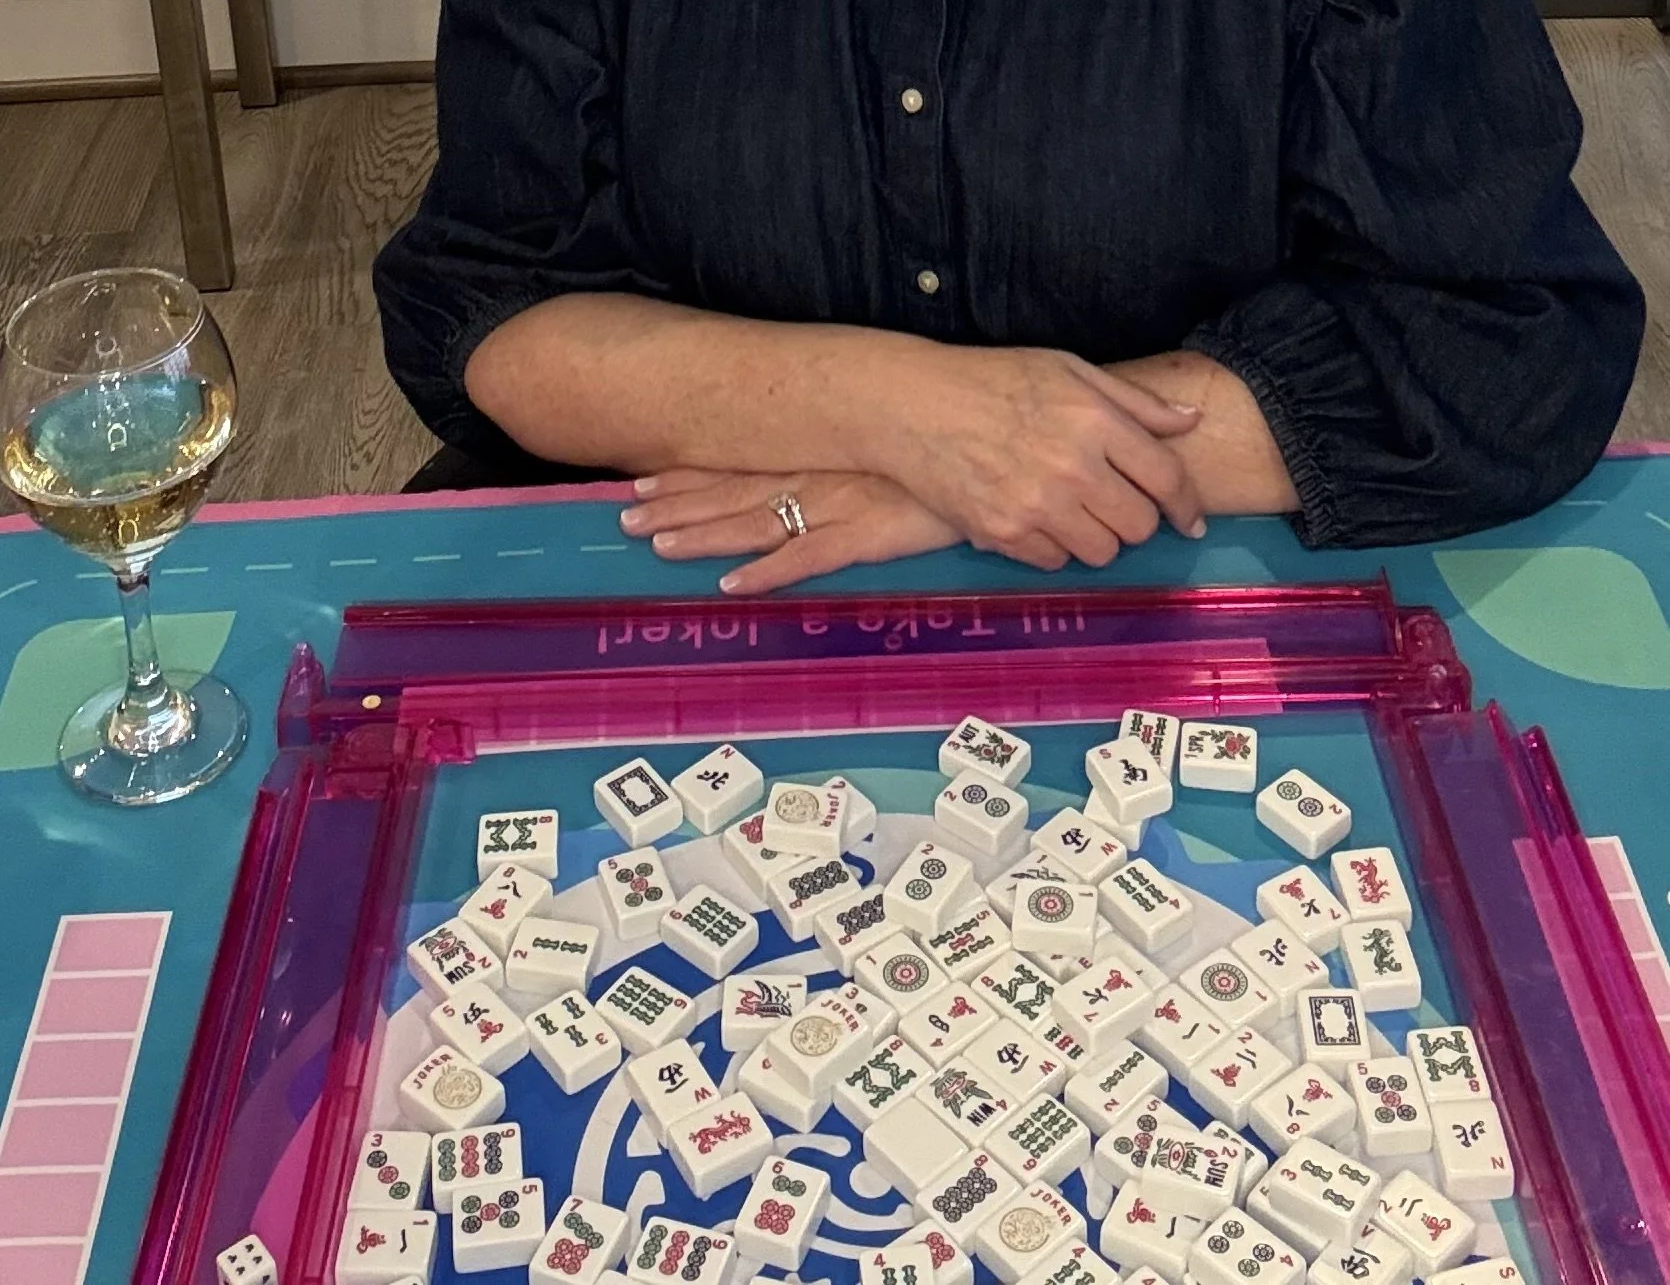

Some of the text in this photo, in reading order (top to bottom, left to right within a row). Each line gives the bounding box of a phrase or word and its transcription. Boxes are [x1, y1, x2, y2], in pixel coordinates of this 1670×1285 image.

[947, 722, 979, 751] 3 AUT
[1188, 735, 1204, 753] SPR
[720, 748, 735, 760] N
[1099, 748, 1112, 759] S
[943, 790, 957, 802] 2
[820, 793, 839, 827] JOKER
[1328, 803, 1342, 815] 2
[921, 843, 935, 855] 2
[1100, 842, 1118, 856] W
[607, 859, 621, 870] 5
[503, 866, 515, 878] 8
[789, 899, 802, 909] 8
[1168, 898, 1180, 909] 4
[976, 910, 990, 921] 5
[1328, 907, 1342, 920] 7
[838, 934, 852, 945] 8
[513, 949, 527, 959] 2
[443, 957, 492, 985] 2 SUM
[1305, 961, 1320, 973] N
[981, 976, 995, 987] 8
[845, 987, 859, 1000] 3
[443, 1004, 456, 1017] 5
[821, 999, 859, 1033] JOKER
[595, 1032, 608, 1045] 3
[1238, 1031, 1253, 1044] 2
[889, 1039, 903, 1051] 8
[412, 1053, 452, 1089] JOKER
[1039, 1060, 1057, 1075] W
[1357, 1063, 1368, 1075] 5
[1469, 1079, 1480, 1092] 8
[694, 1087, 712, 1103] W
[1104, 1098, 1120, 1111] 2
[1146, 1100, 1161, 1112] 5
[967, 1099, 1008, 1127] 4 WIN
[1286, 1122, 1300, 1134] 8
[371, 1133, 383, 1147] 3
[974, 1154, 989, 1167] 8
[1203, 1146, 1238, 1188] 2 SUM
[1491, 1156, 1505, 1169] N
[772, 1161, 785, 1174] 6
[1281, 1168, 1297, 1181] 3
[522, 1184, 538, 1195] 5
[569, 1199, 583, 1212] 7
[1030, 1188, 1072, 1226] JOKER
[1072, 1247, 1086, 1259] 4
[873, 1253, 886, 1267] 4
[1280, 1254, 1294, 1267] 4
